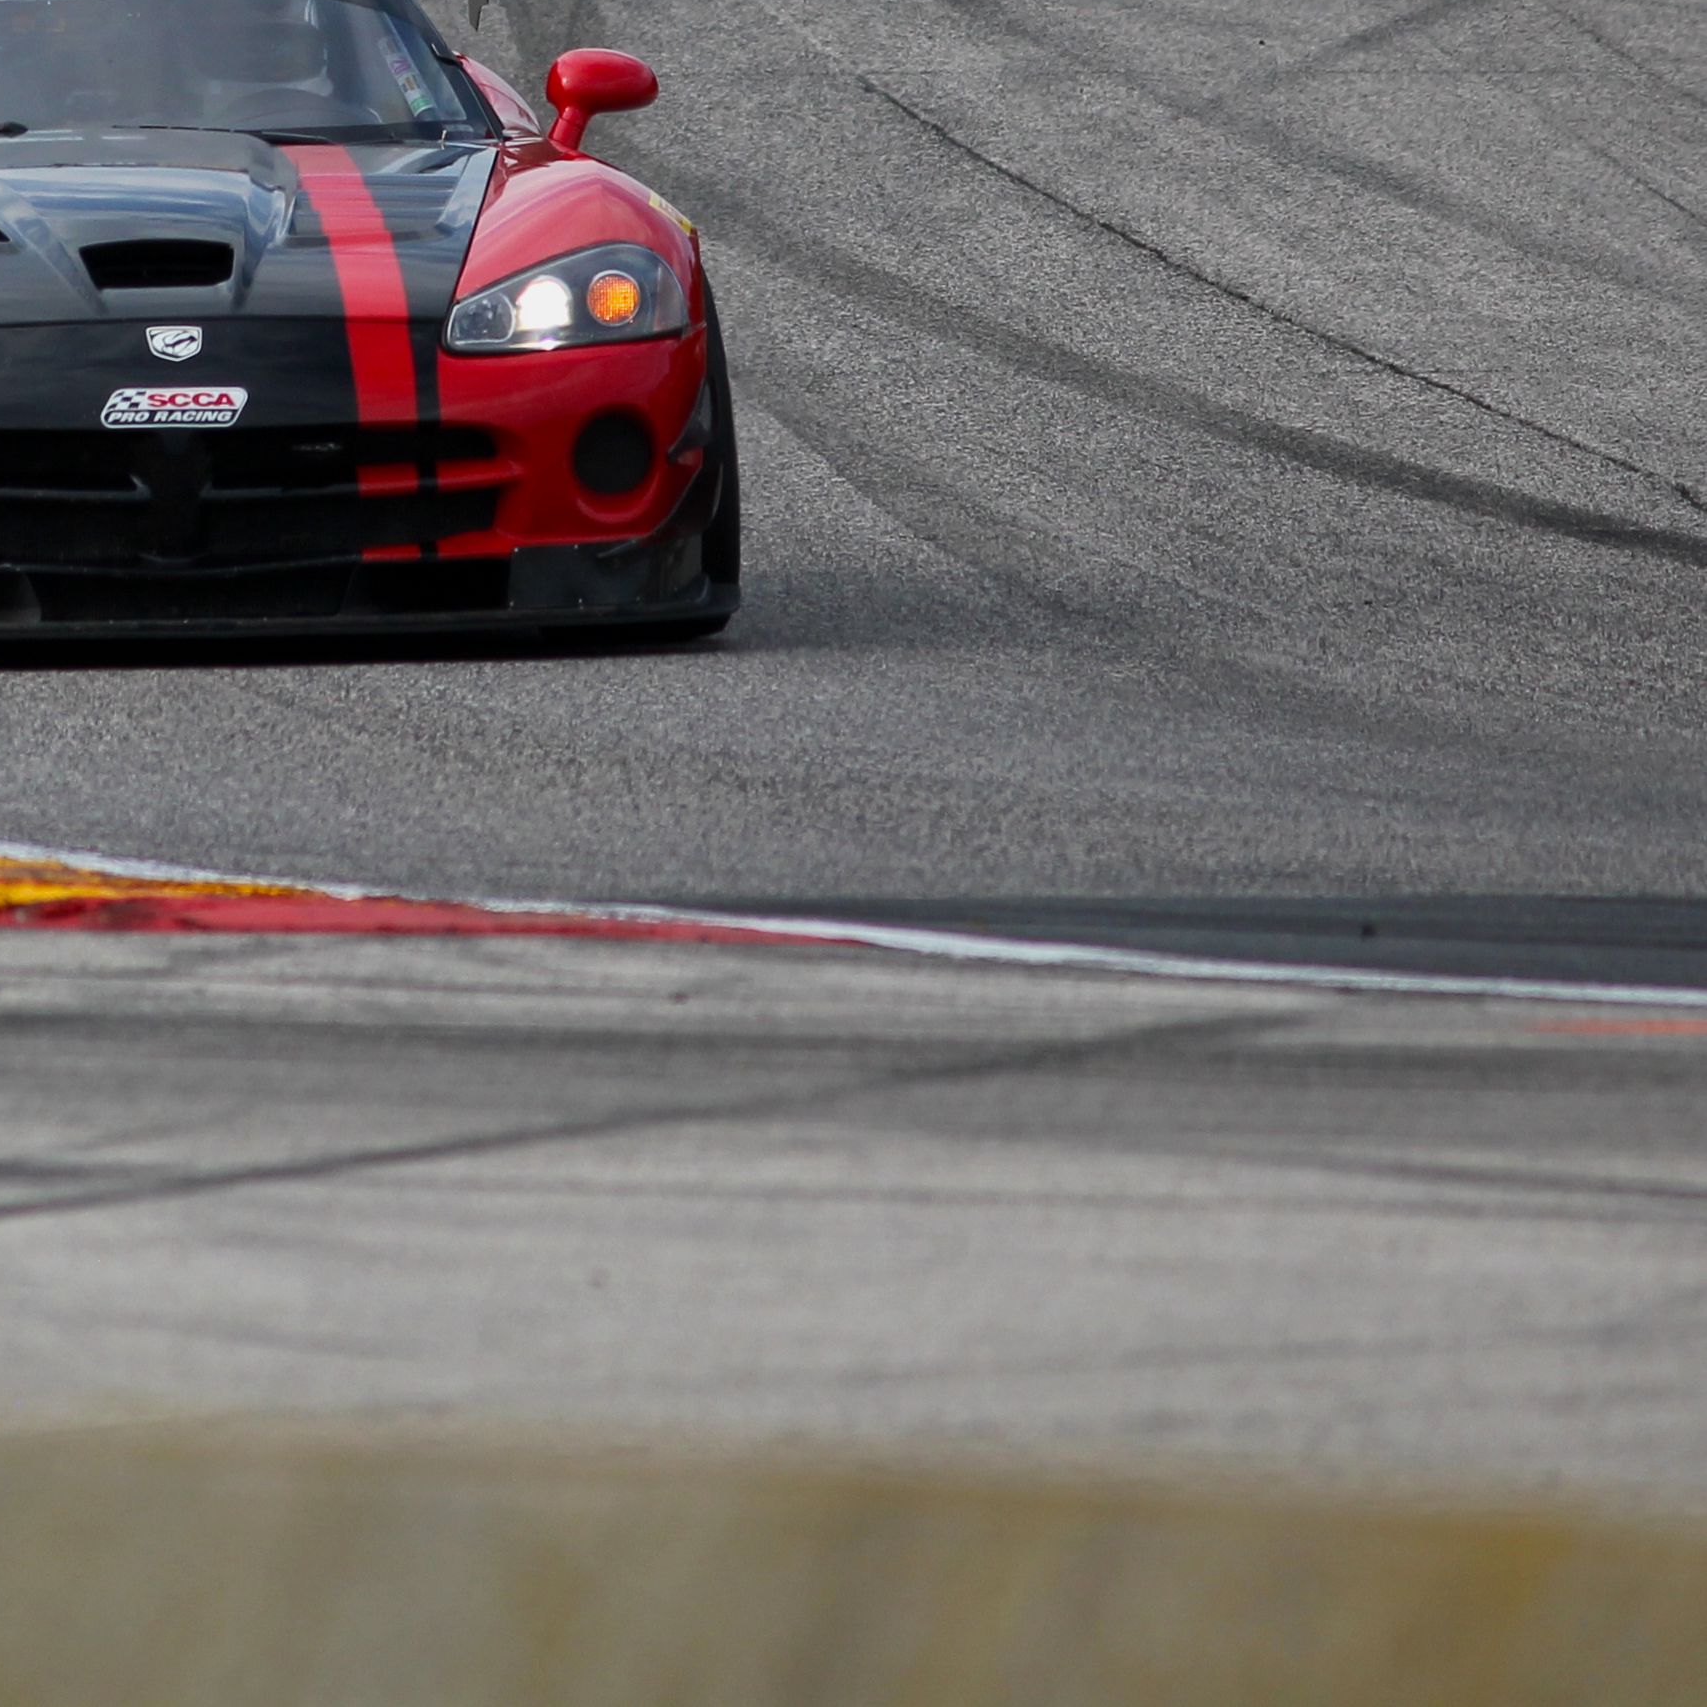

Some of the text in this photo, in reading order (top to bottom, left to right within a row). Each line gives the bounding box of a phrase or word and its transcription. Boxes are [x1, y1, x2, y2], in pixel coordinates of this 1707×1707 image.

[146, 392, 236, 408] SCCA
[107, 410, 234, 423] PRO RACING
